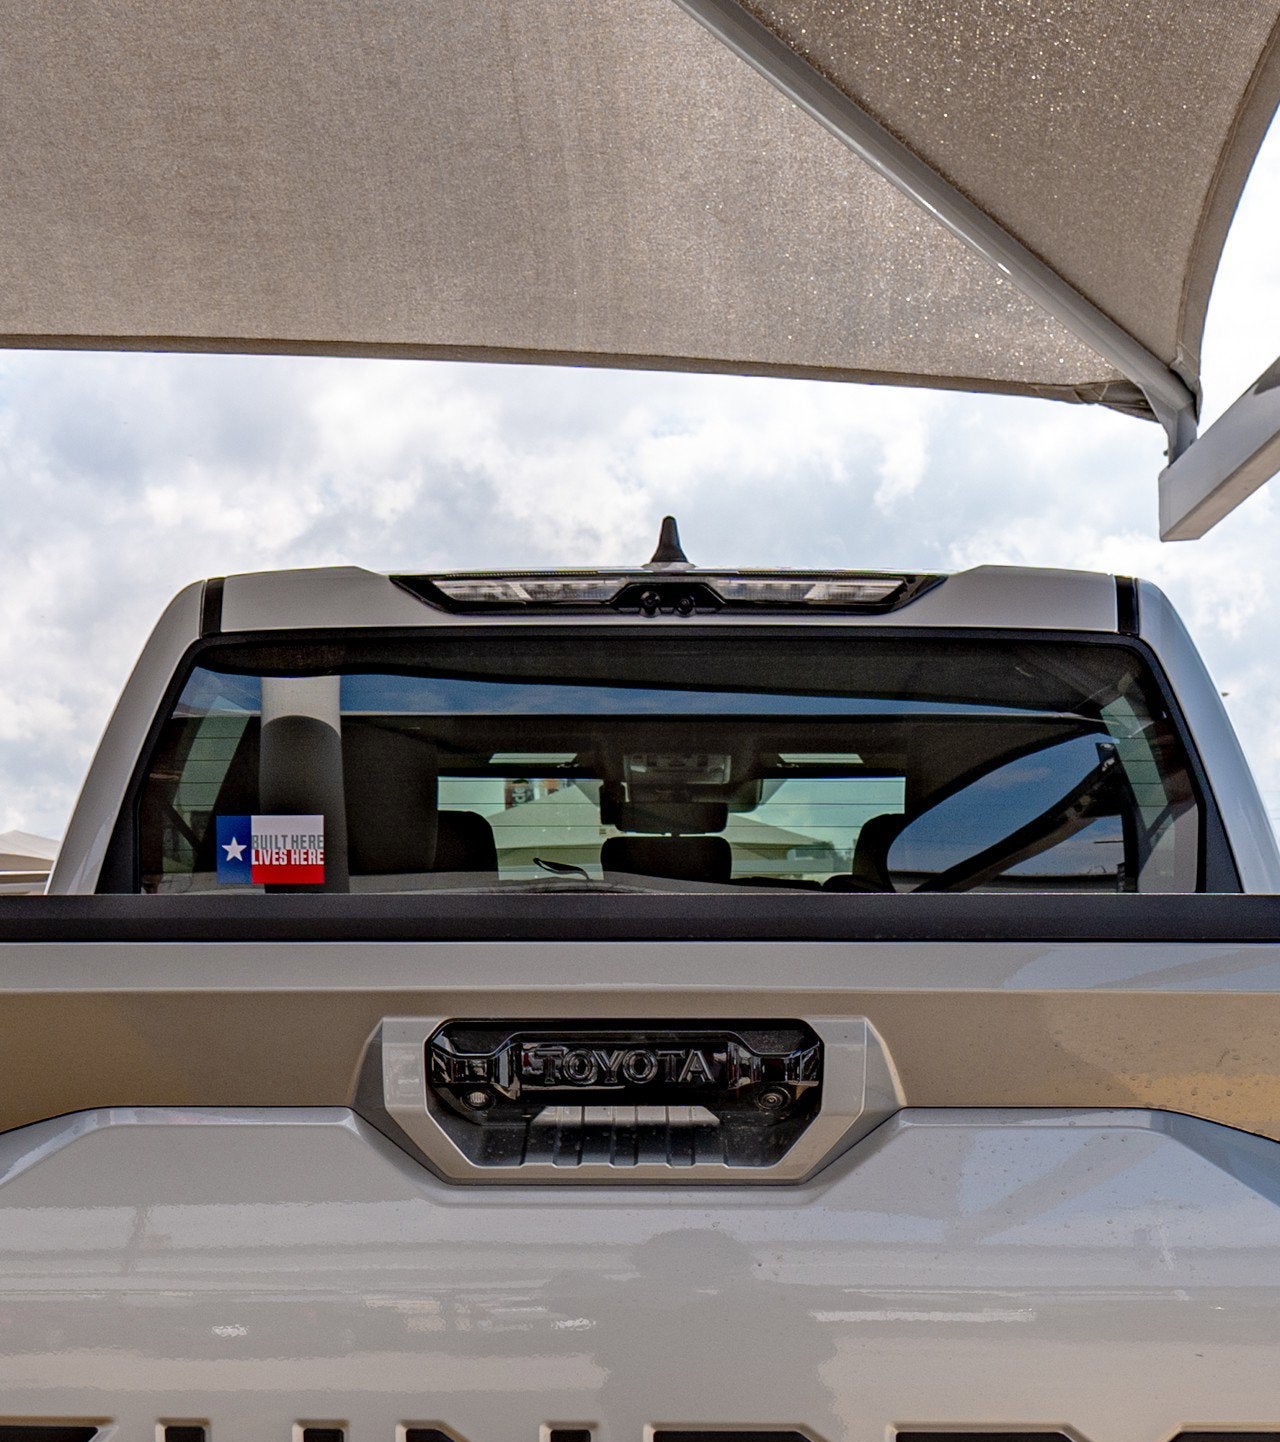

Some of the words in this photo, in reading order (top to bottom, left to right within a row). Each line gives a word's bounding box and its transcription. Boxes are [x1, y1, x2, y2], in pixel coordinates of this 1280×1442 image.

[251, 834, 288, 849] BUILT
[291, 834, 324, 849] HERE
[251, 849, 288, 865] LIVES
[291, 848, 324, 865] HERE
[534, 1047, 716, 1085] TOYOTA
